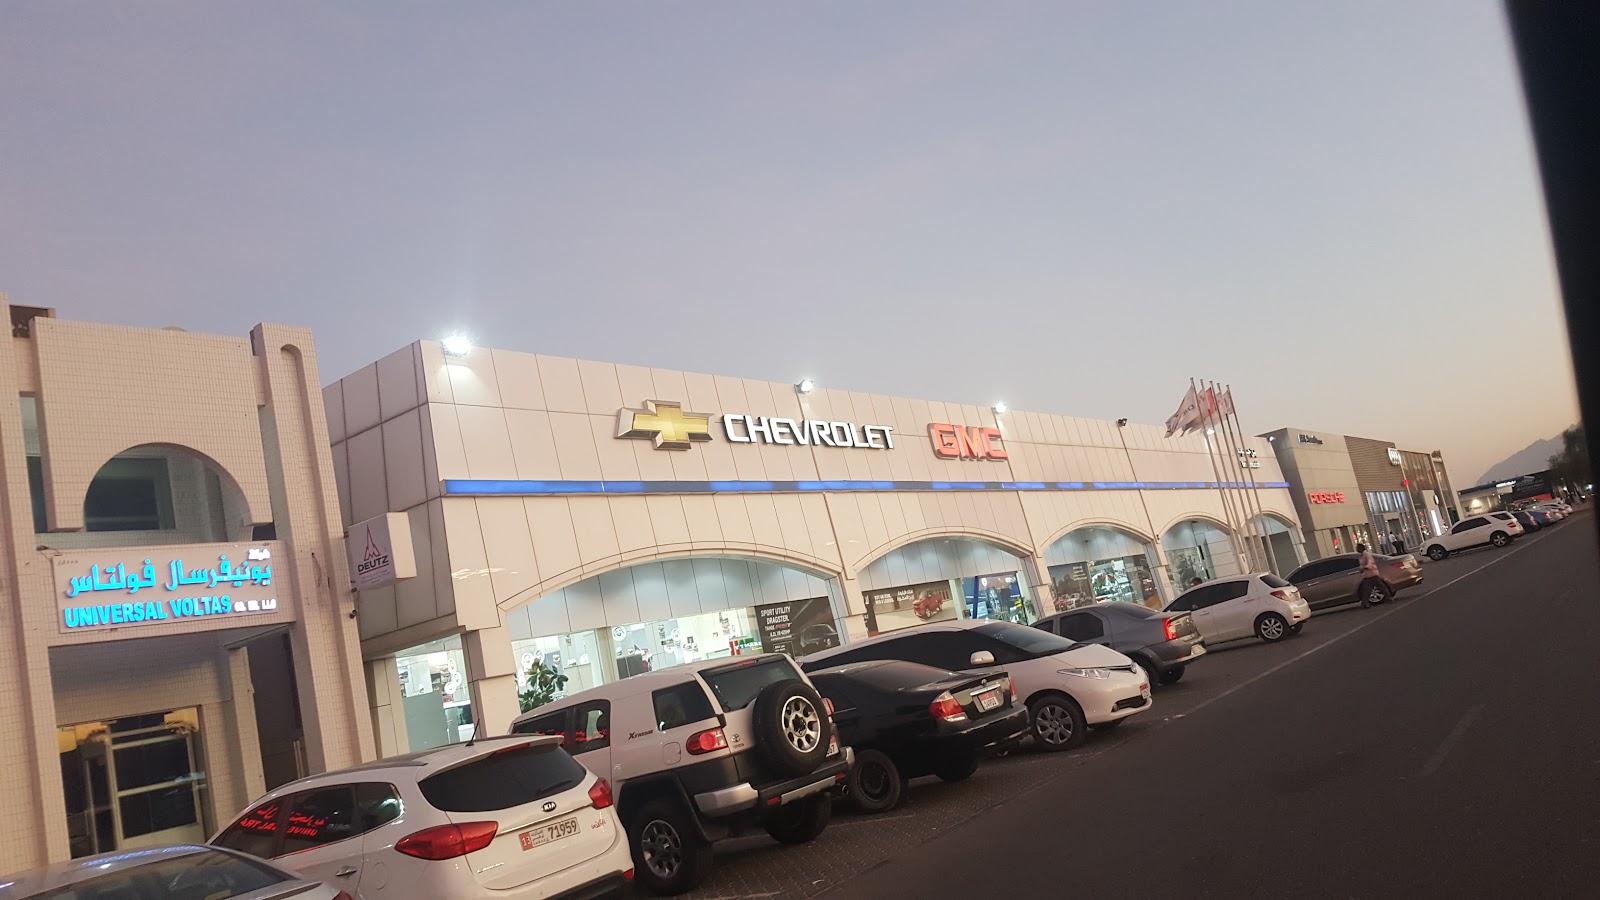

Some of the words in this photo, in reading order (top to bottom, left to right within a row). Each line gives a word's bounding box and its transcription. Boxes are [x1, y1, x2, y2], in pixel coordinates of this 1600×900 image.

[723, 413, 895, 450] CHEVROLET
[927, 422, 1008, 462] GMC
[1308, 491, 1345, 504] PORSCHE
[66, 558, 156, 598] فولتاس
[164, 554, 272, 592] يونيفرسال
[357, 555, 389, 573] DEUTZ
[64, 600, 168, 628] UNIVERSAL
[170, 595, 232, 618] VOLTAS
[543, 802, 556, 811] KIA
[521, 836, 532, 847] 13
[547, 820, 577, 840] 71959
